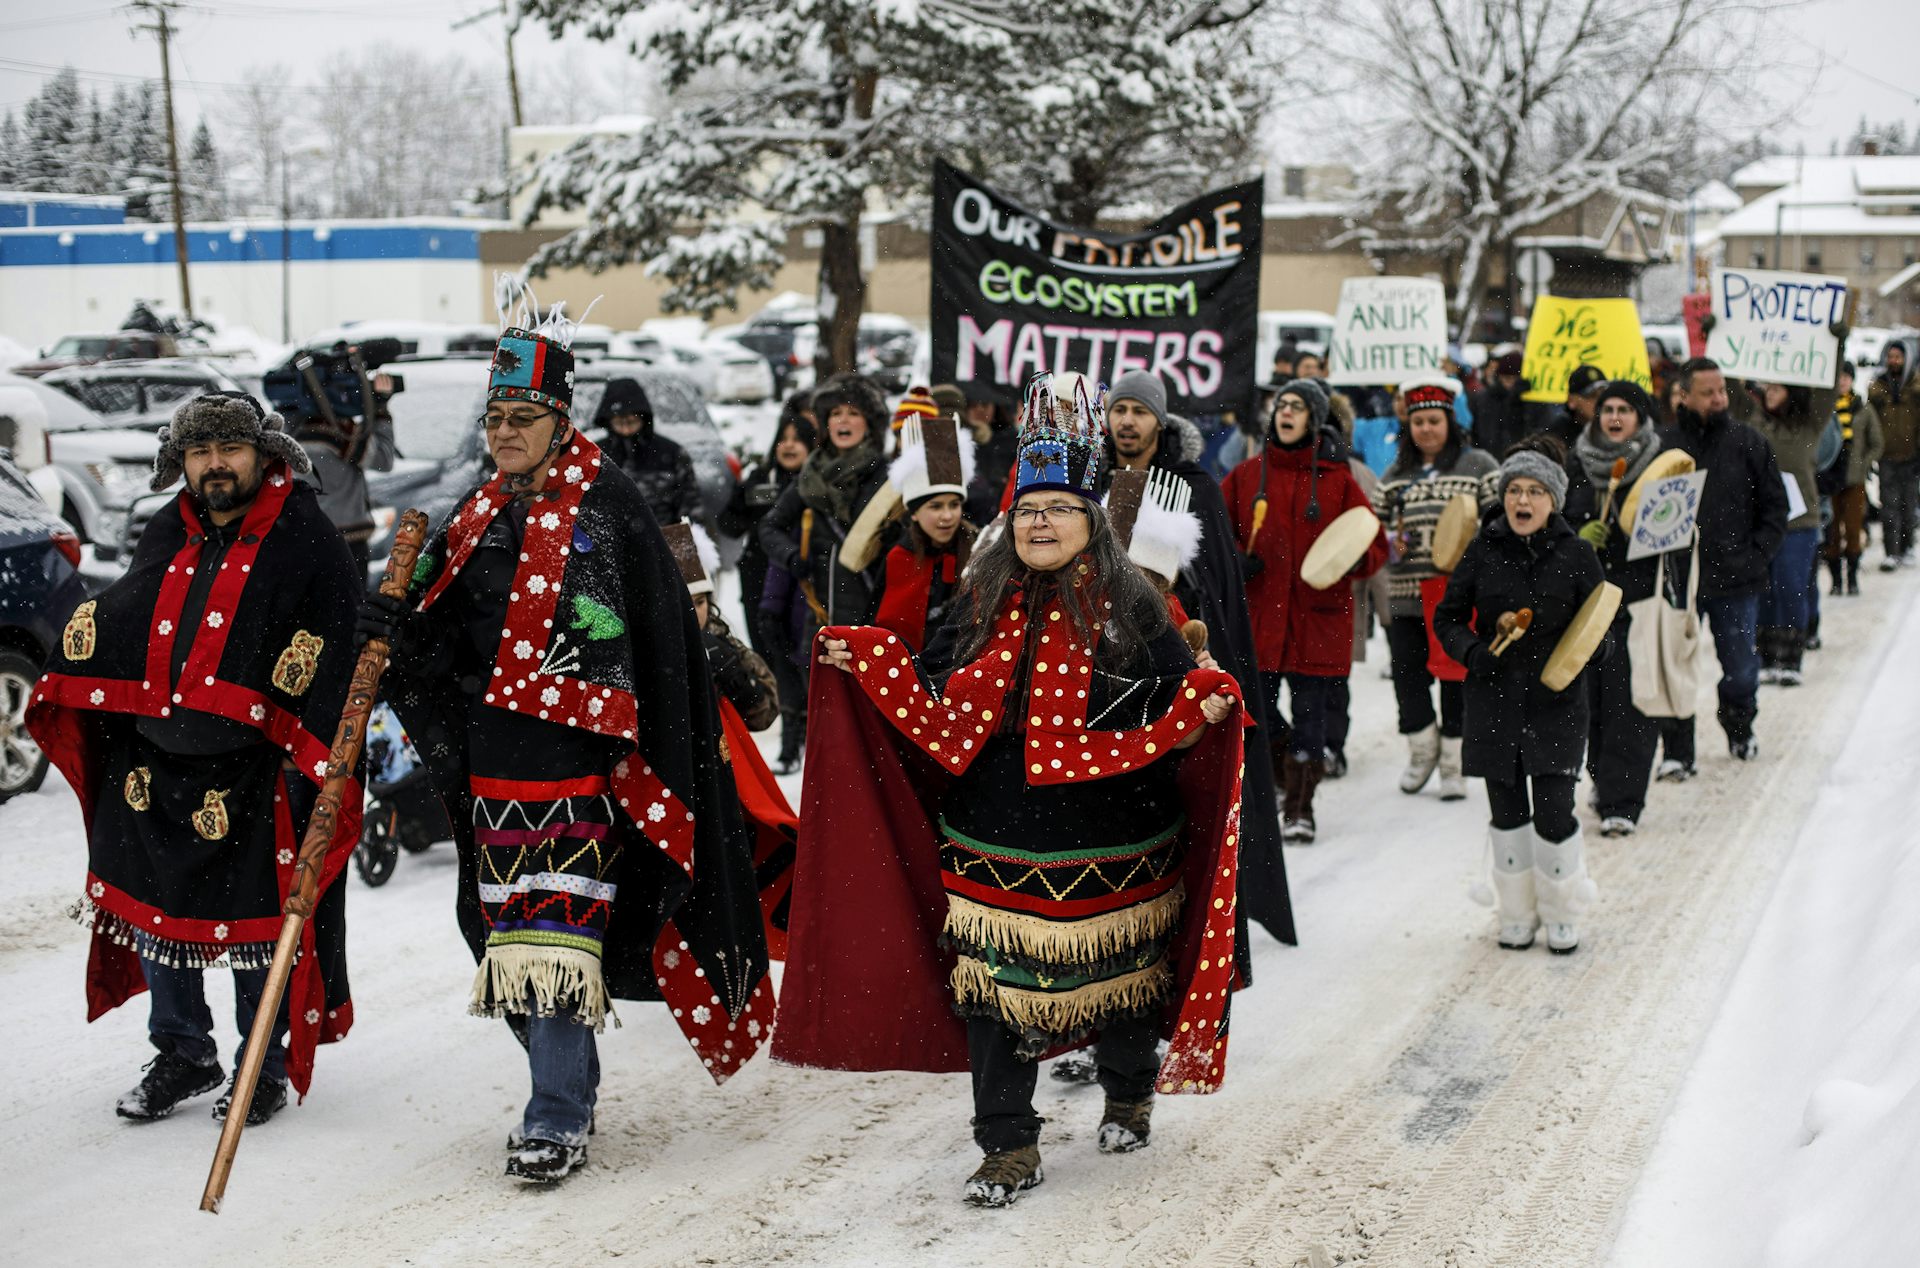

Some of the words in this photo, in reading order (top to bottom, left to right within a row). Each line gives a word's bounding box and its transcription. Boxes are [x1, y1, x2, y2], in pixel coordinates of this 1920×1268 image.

[952, 187, 1042, 250] OUR
[1350, 302, 1429, 332] ANUK
[1722, 272, 1847, 326] PROTECT
[1554, 305, 1599, 338] We
[1760, 326, 1791, 345] the
[955, 313, 1224, 398] MATTERS
[1537, 342, 1602, 362] are
[1719, 335, 1828, 380] Yintah
[1640, 497, 1658, 521] ALL
[1658, 478, 1689, 496] EYES
